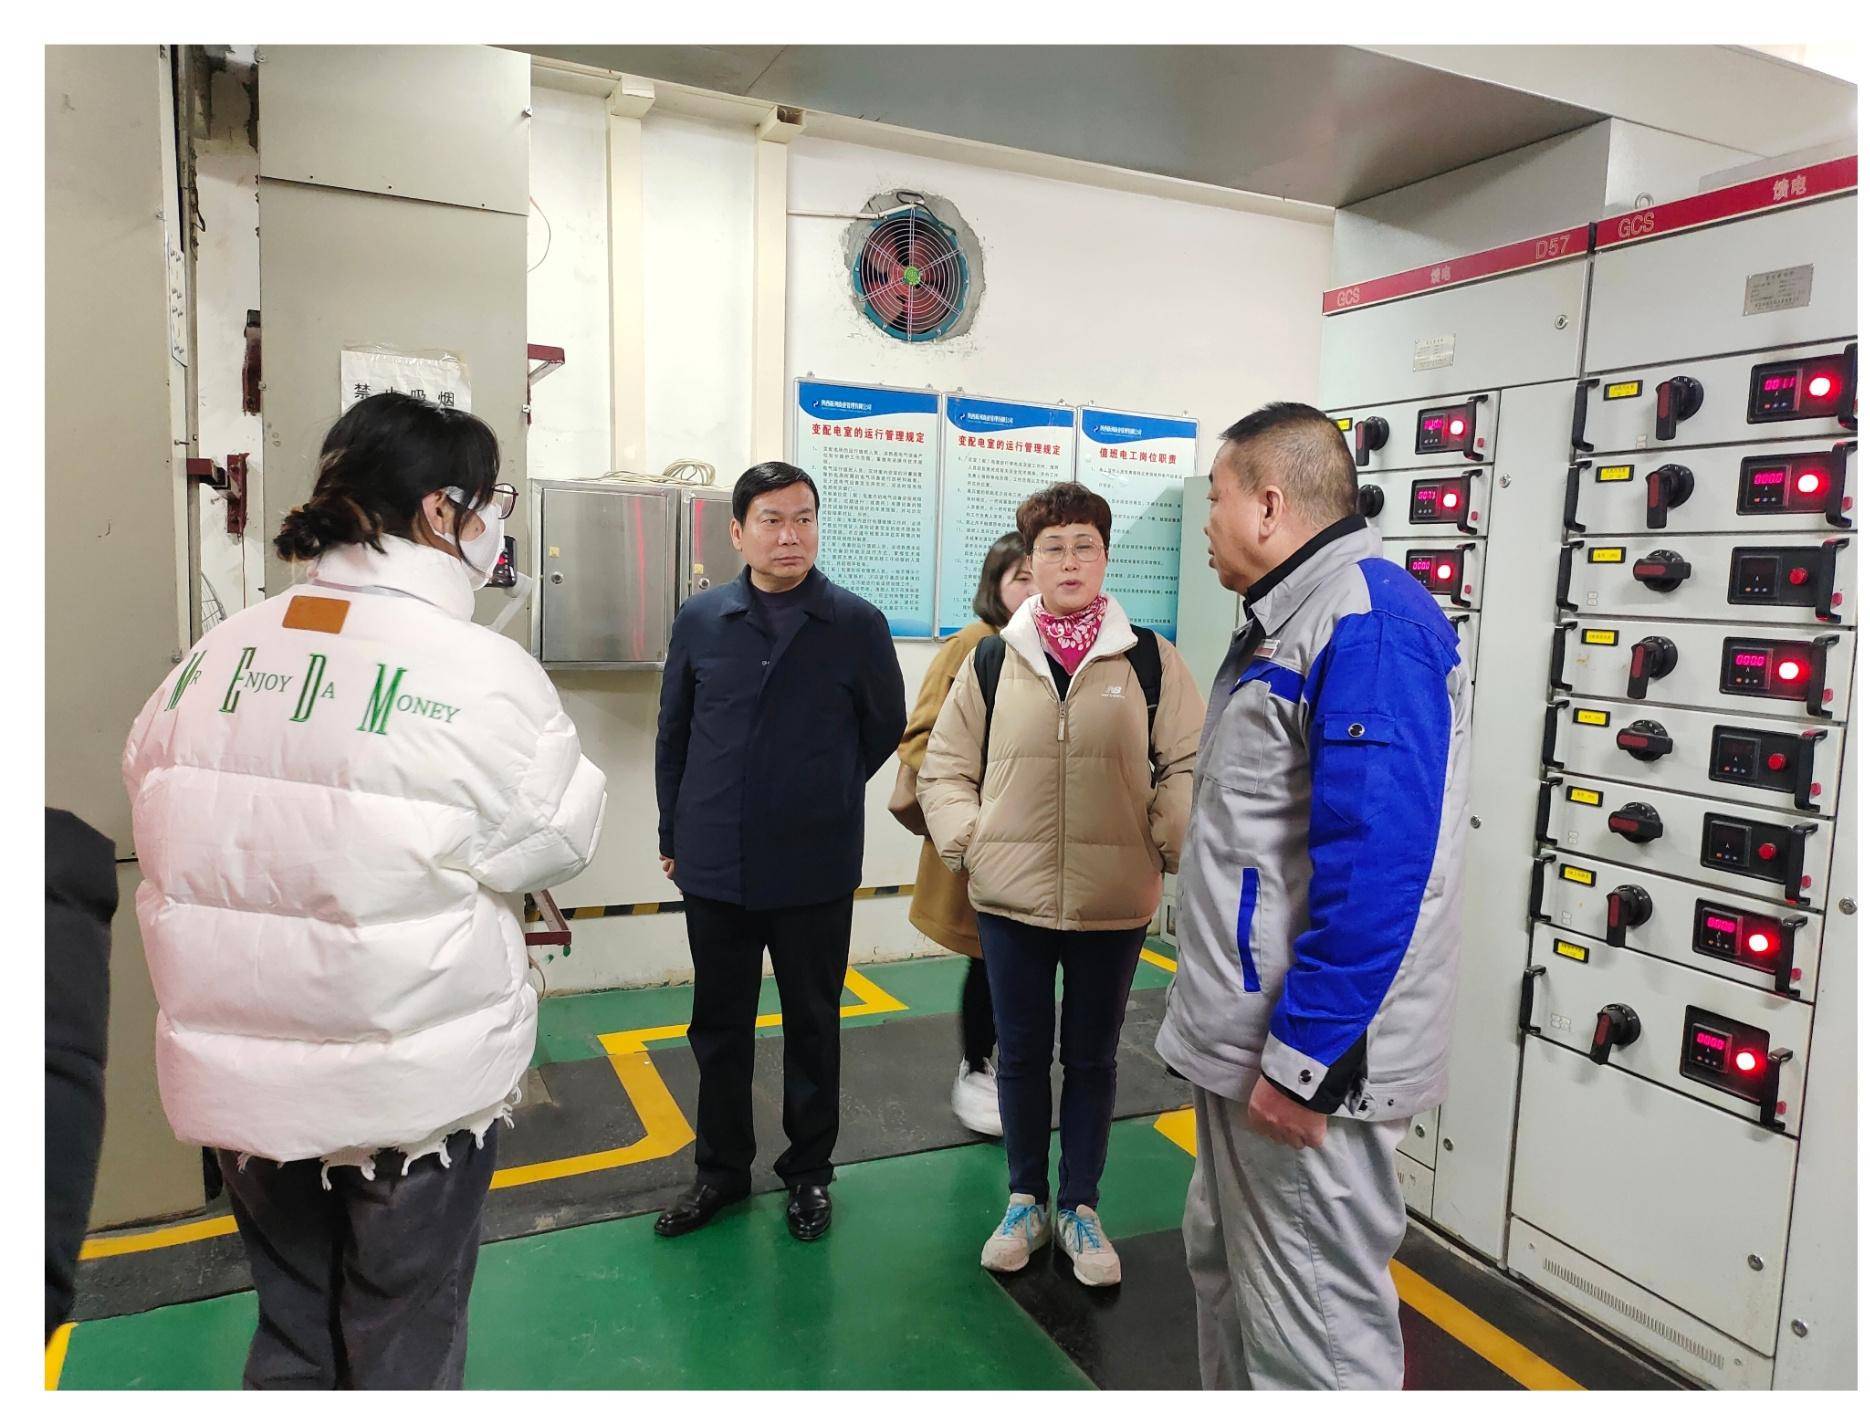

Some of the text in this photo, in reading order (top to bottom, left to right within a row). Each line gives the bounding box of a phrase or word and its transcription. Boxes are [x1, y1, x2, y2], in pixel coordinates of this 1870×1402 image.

[1618, 212, 1655, 238] GCS
[1337, 287, 1361, 307] GCS
[1535, 235, 1571, 260] D57
[811, 423, 926, 444] 变配电室的运行管理规定
[958, 435, 1061, 456] 变配电室的运行管理规定
